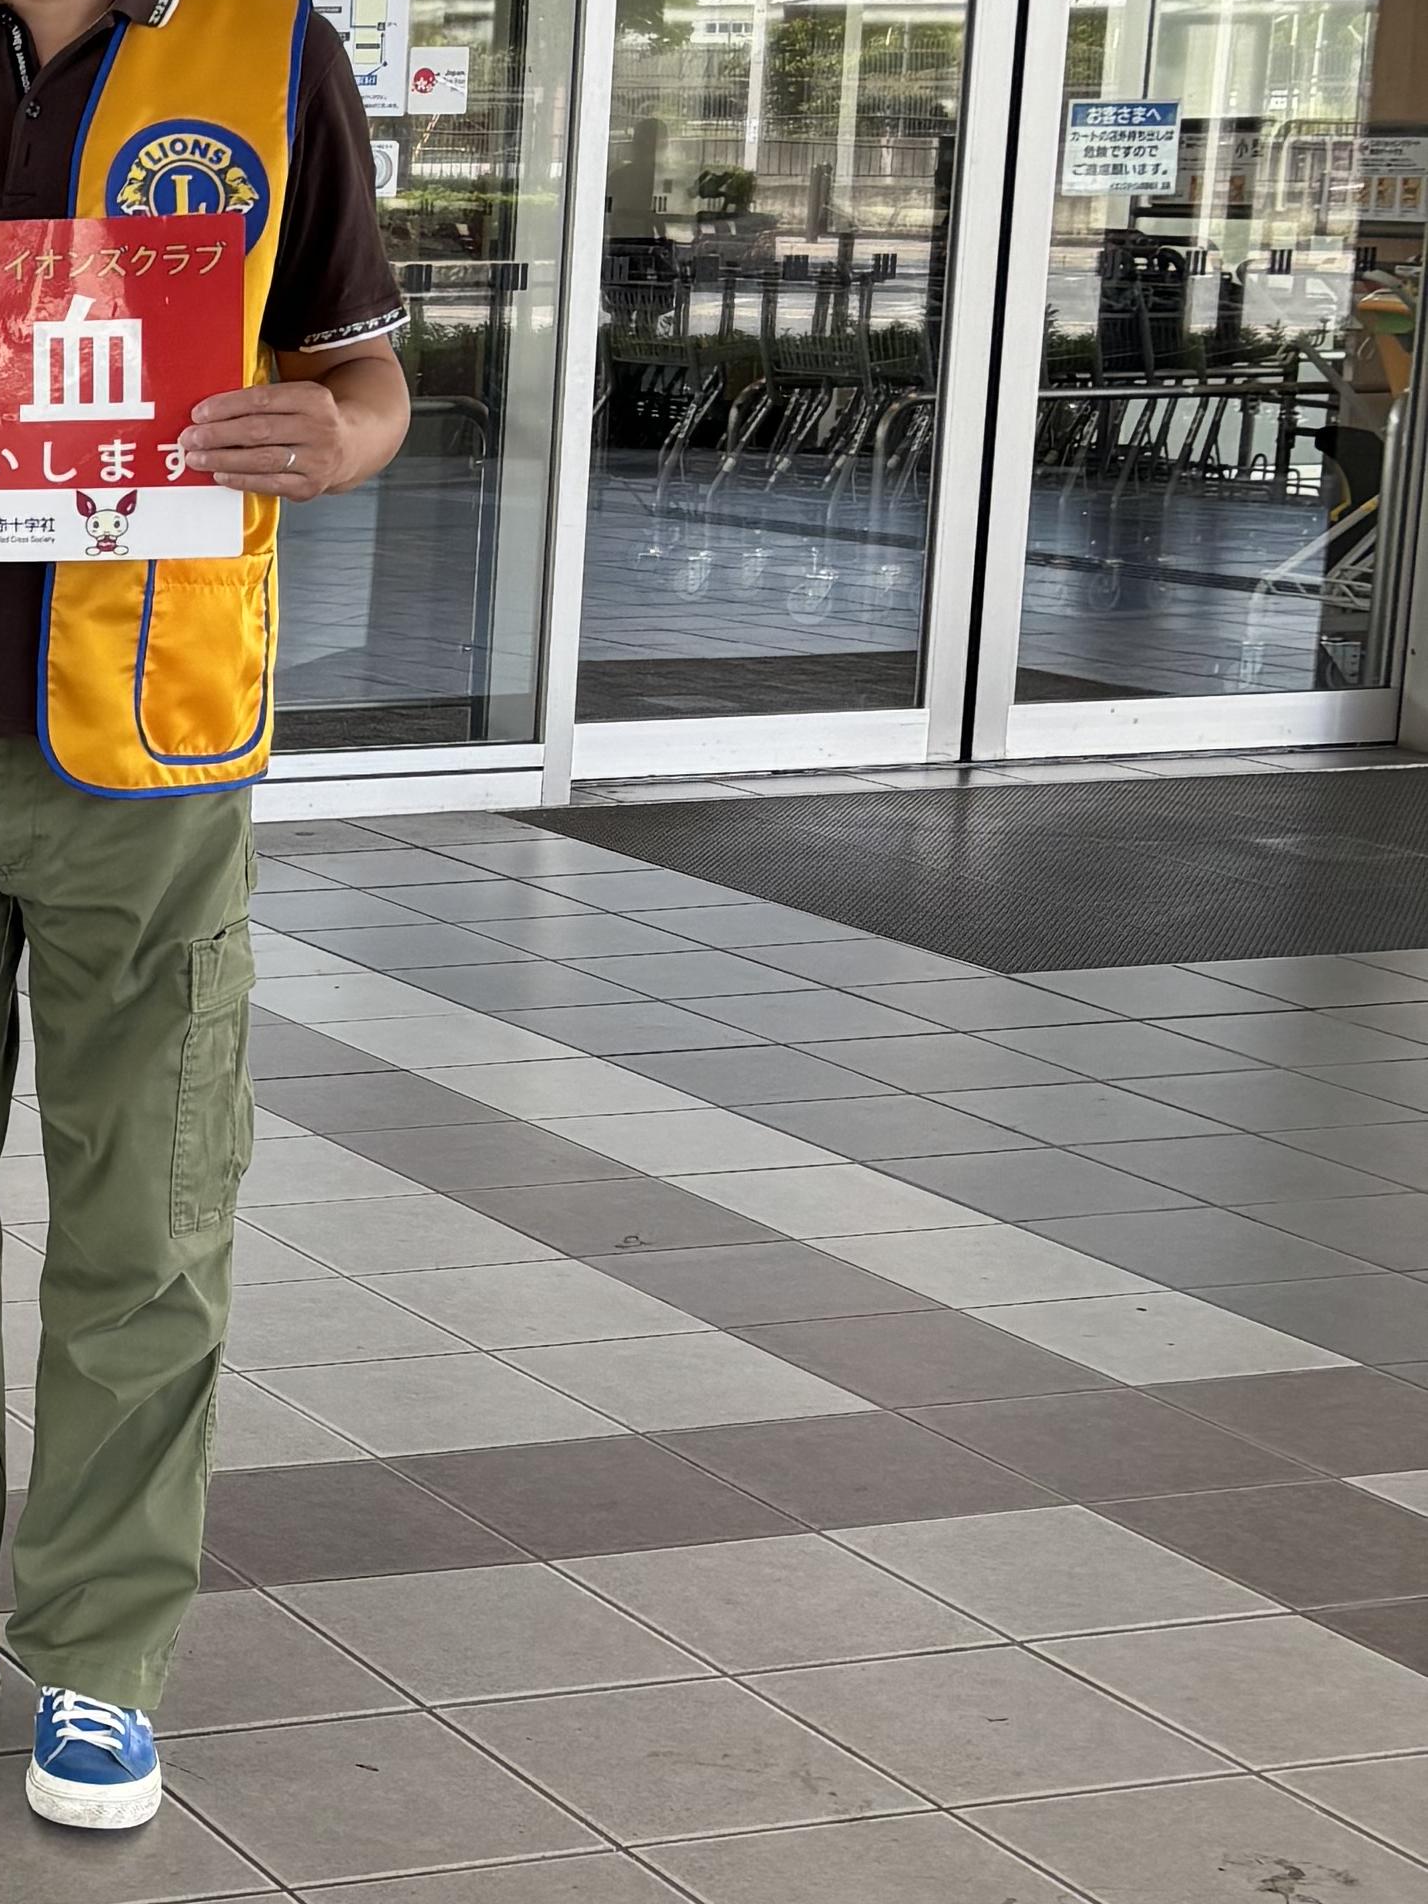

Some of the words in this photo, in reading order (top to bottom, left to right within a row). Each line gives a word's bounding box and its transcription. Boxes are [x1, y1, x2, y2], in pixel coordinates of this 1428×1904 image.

[1086, 106, 1162, 125] お客さまへ
[145, 137, 227, 166] LIONS
[1084, 146, 1159, 158] 危険ですので
[171, 174, 206, 215] L
